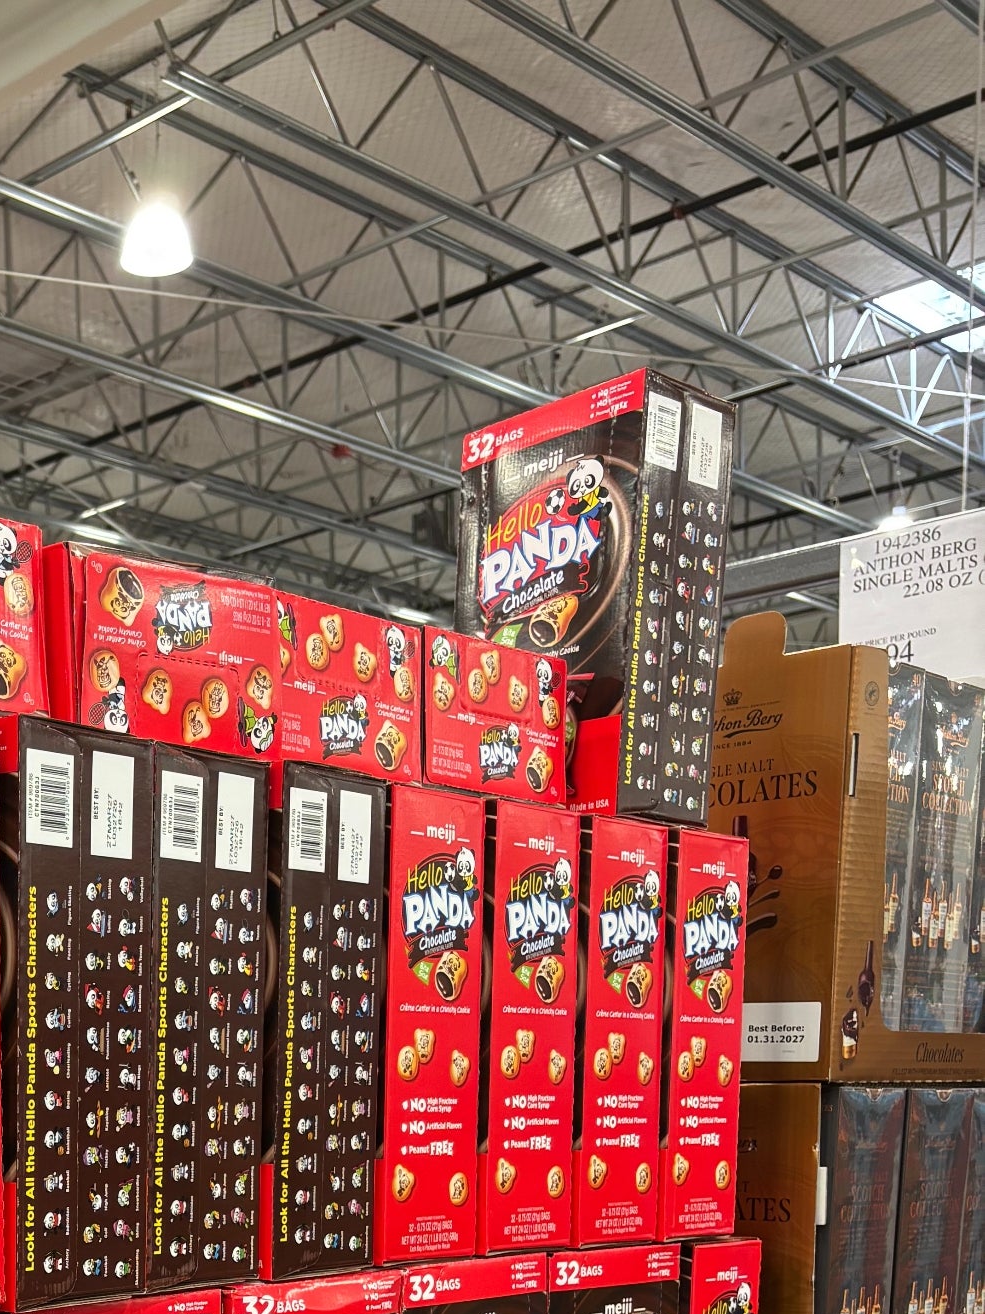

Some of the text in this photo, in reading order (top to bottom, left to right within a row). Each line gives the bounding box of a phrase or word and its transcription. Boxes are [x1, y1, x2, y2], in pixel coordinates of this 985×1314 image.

[467, 428, 524, 463] 32 BAGS
[523, 449, 563, 477] meiji
[875, 525, 942, 555] 1942386
[481, 517, 602, 604] PANDA
[854, 538, 976, 577] ANTHON BERG
[853, 554, 978, 594] SINGLE MALTS
[903, 572, 973, 598] 22.08 OZ
[157, 599, 213, 630] PANDA
[865, 628, 936, 646] PRICE PER POUND
[744, 709, 783, 730] Berg
[479, 743, 520, 769] PANDA
[737, 758, 774, 774] MALT
[596, 799, 609, 808] USA
[402, 883, 475, 938] PANDA
[683, 912, 739, 958] PANDA
[747, 1035, 805, 1044] 01.31.2027
[748, 1023, 805, 1033] Best Before:
[916, 1042, 964, 1064] Chocolates
